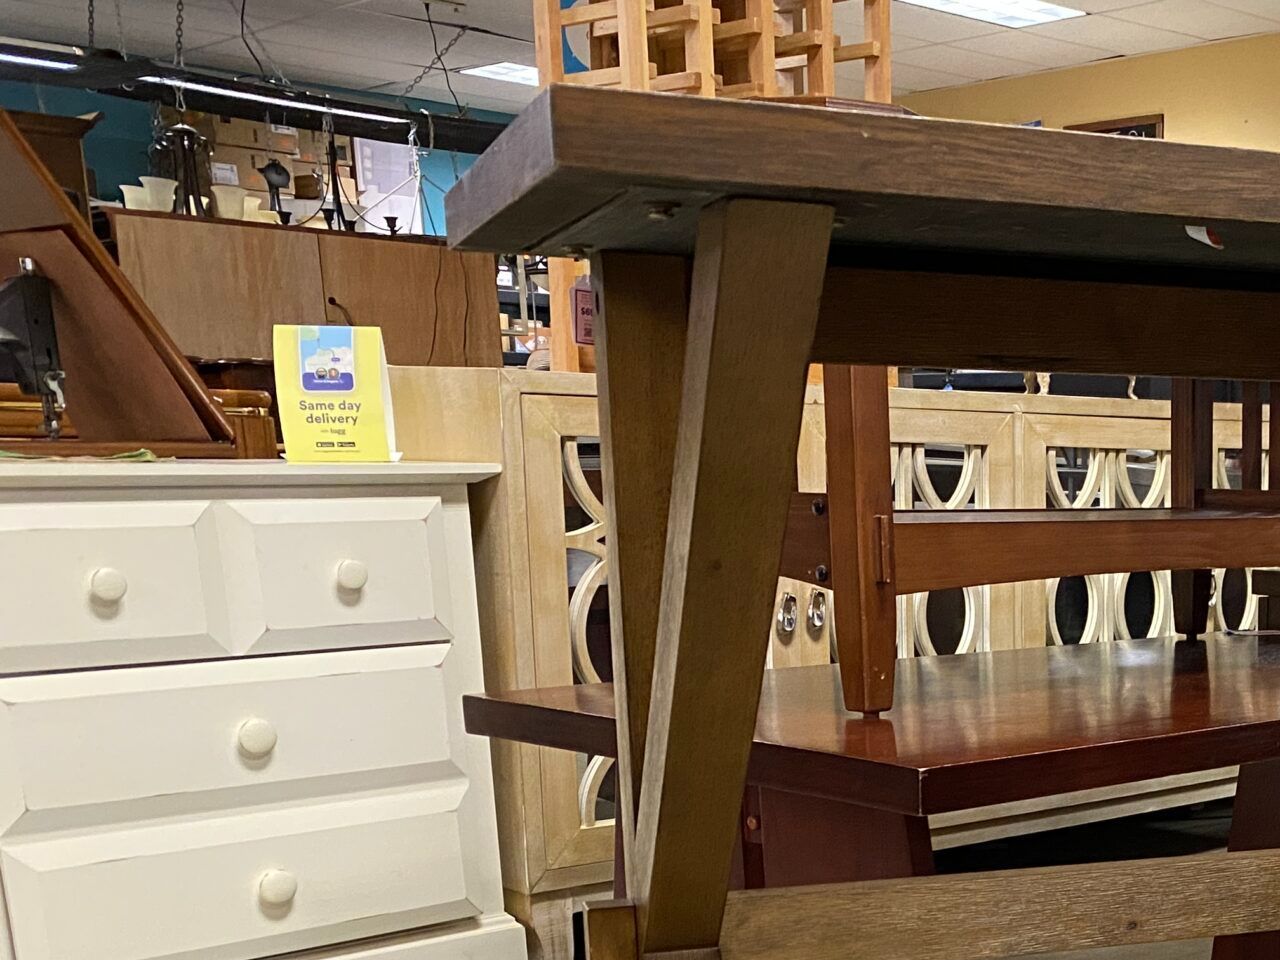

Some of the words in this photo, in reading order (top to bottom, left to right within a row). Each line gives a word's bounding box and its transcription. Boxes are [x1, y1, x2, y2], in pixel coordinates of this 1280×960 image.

[299, 400, 335, 410] Same
[338, 400, 361, 412] day
[306, 413, 358, 425] delivery
